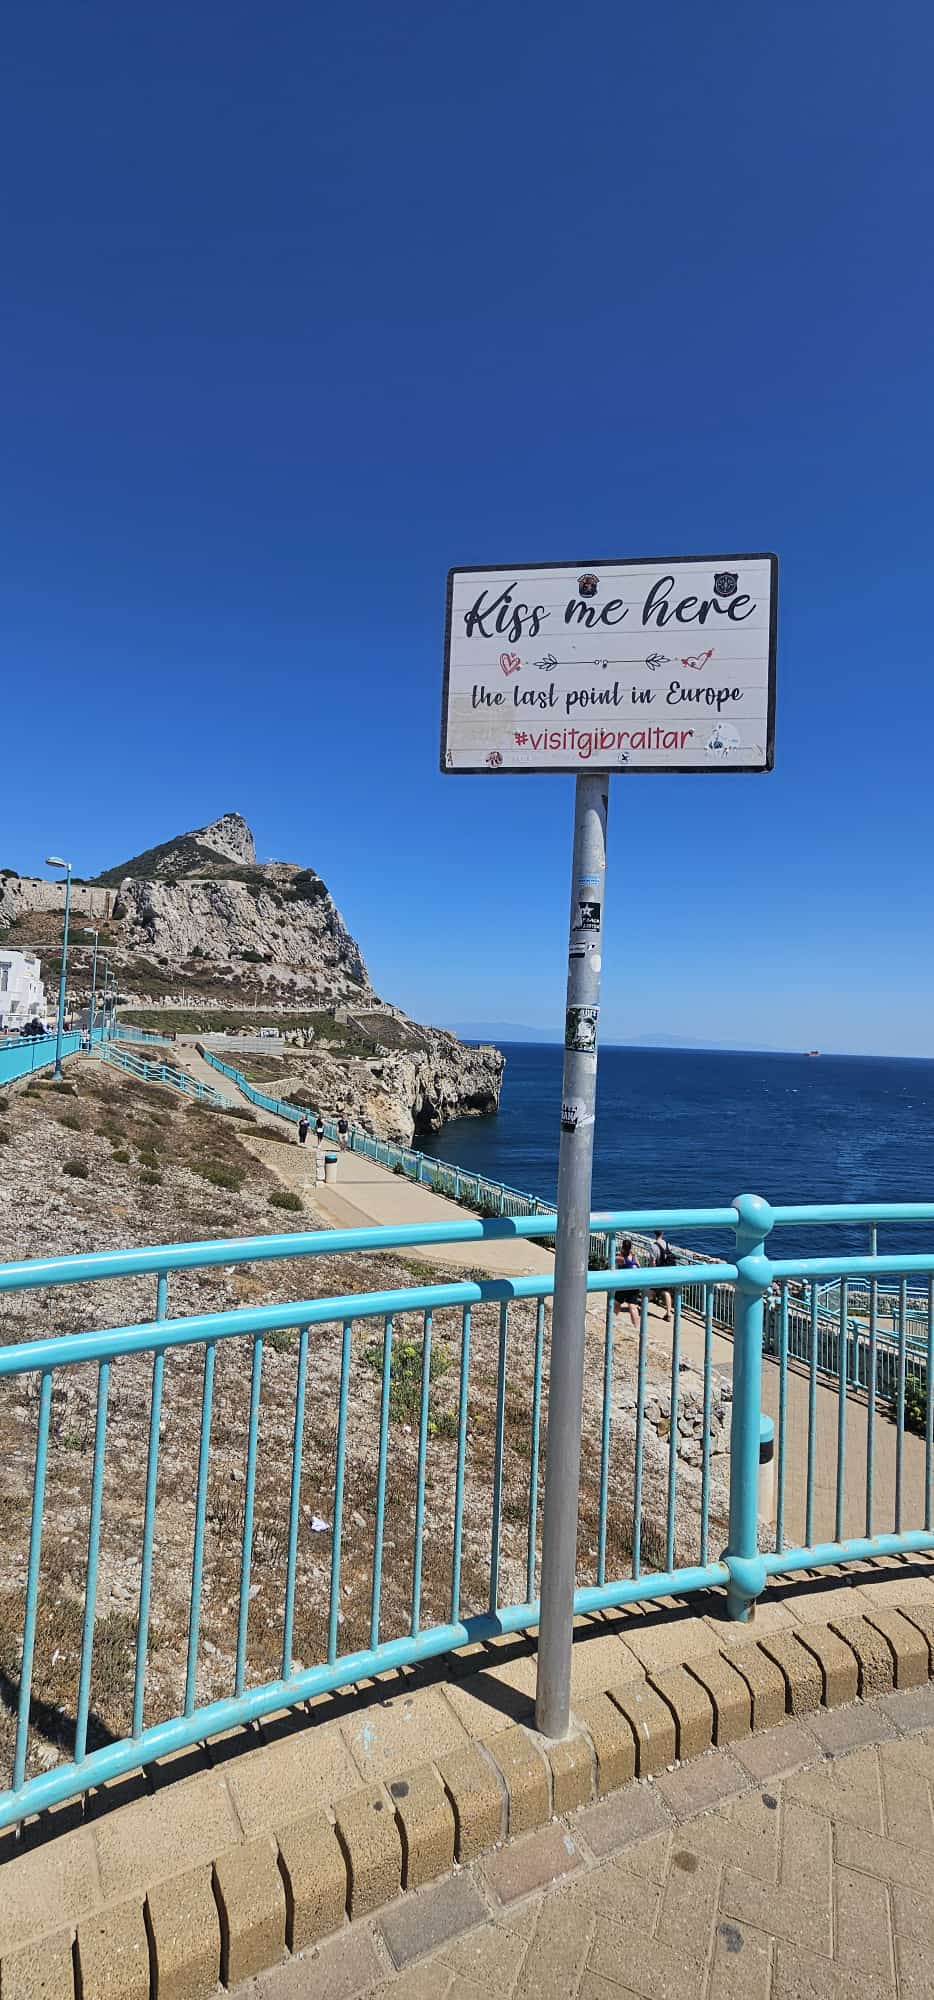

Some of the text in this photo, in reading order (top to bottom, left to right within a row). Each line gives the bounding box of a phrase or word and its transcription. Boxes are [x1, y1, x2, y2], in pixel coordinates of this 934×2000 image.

[464, 575, 757, 643] Kiss me here
[471, 681, 744, 715] the last point in Europe
[514, 727, 694, 759] #visitgibraltar
